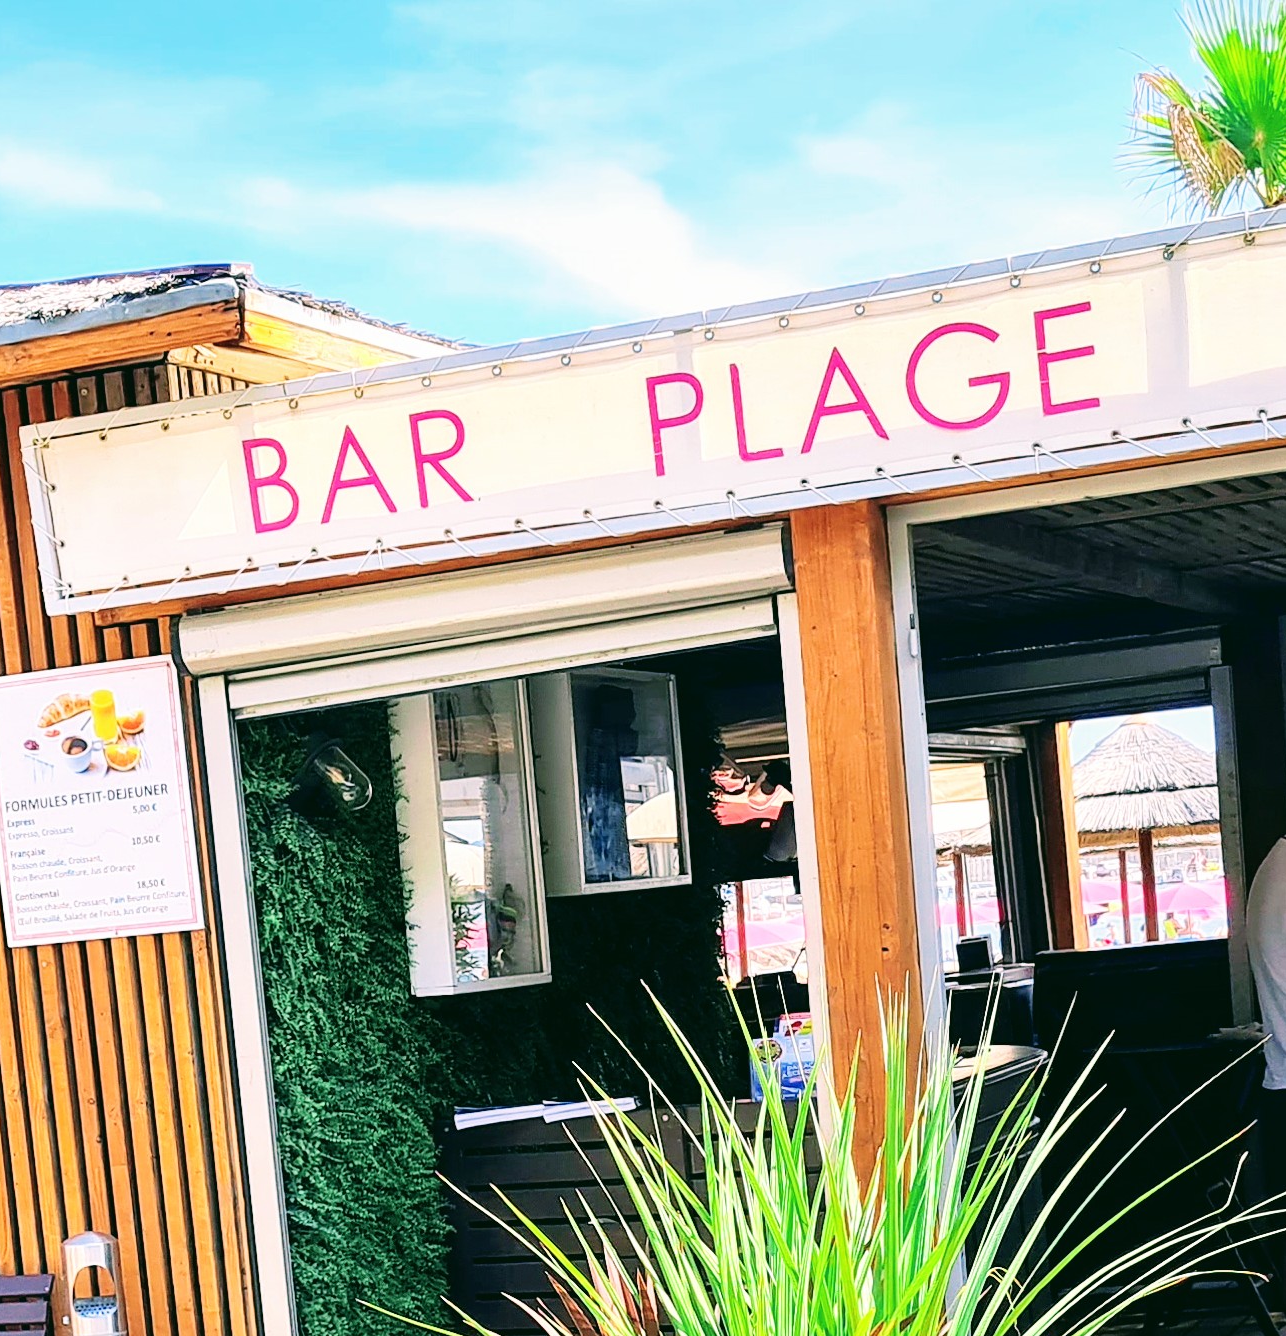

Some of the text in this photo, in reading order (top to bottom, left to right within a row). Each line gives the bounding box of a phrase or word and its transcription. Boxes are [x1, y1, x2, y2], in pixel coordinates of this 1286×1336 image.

[243, 409, 473, 534] BAR
[647, 301, 1101, 477] PLAGE
[5, 783, 169, 813] FORMULES PETIT-DEJEUNER
[132, 804, 150, 815] 5,00
[132, 835, 154, 846] 10,50
[137, 879, 159, 889] 18,50
[15, 889, 60, 902] Continental
